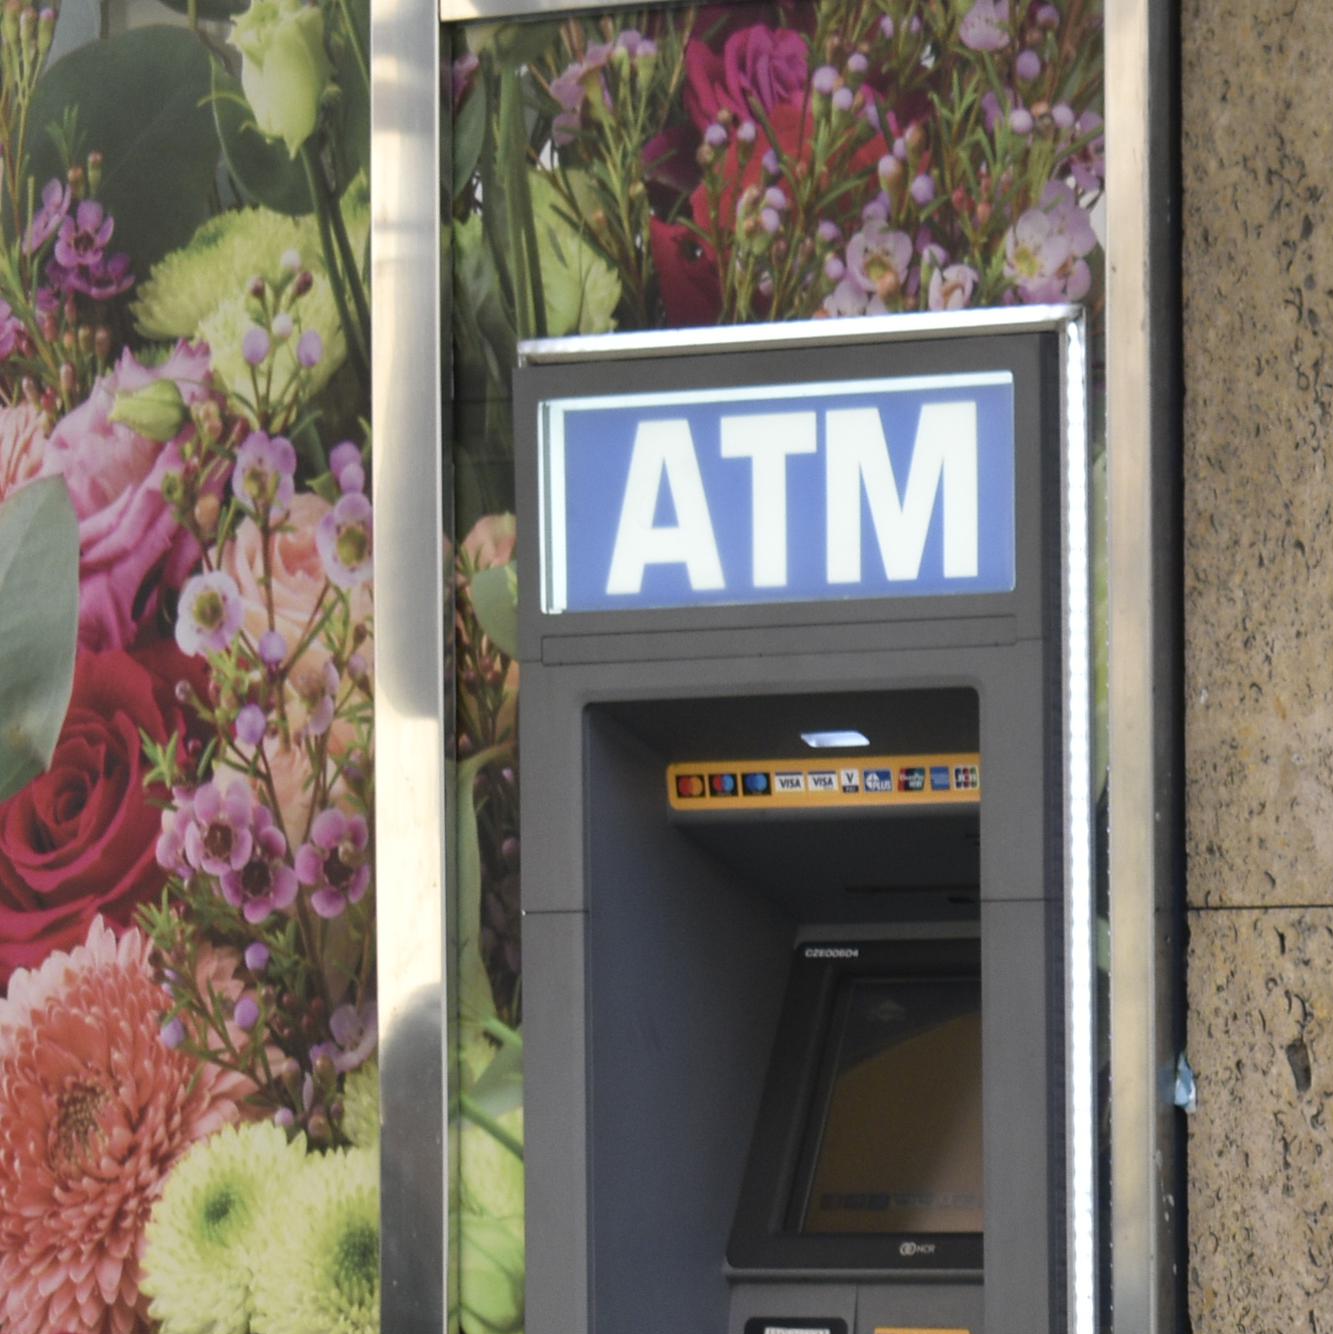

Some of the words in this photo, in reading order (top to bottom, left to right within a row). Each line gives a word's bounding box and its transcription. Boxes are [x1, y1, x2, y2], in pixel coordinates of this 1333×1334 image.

[605, 400, 979, 595] ATM
[778, 778, 801, 789] VISA
[812, 776, 833, 787] VISA
